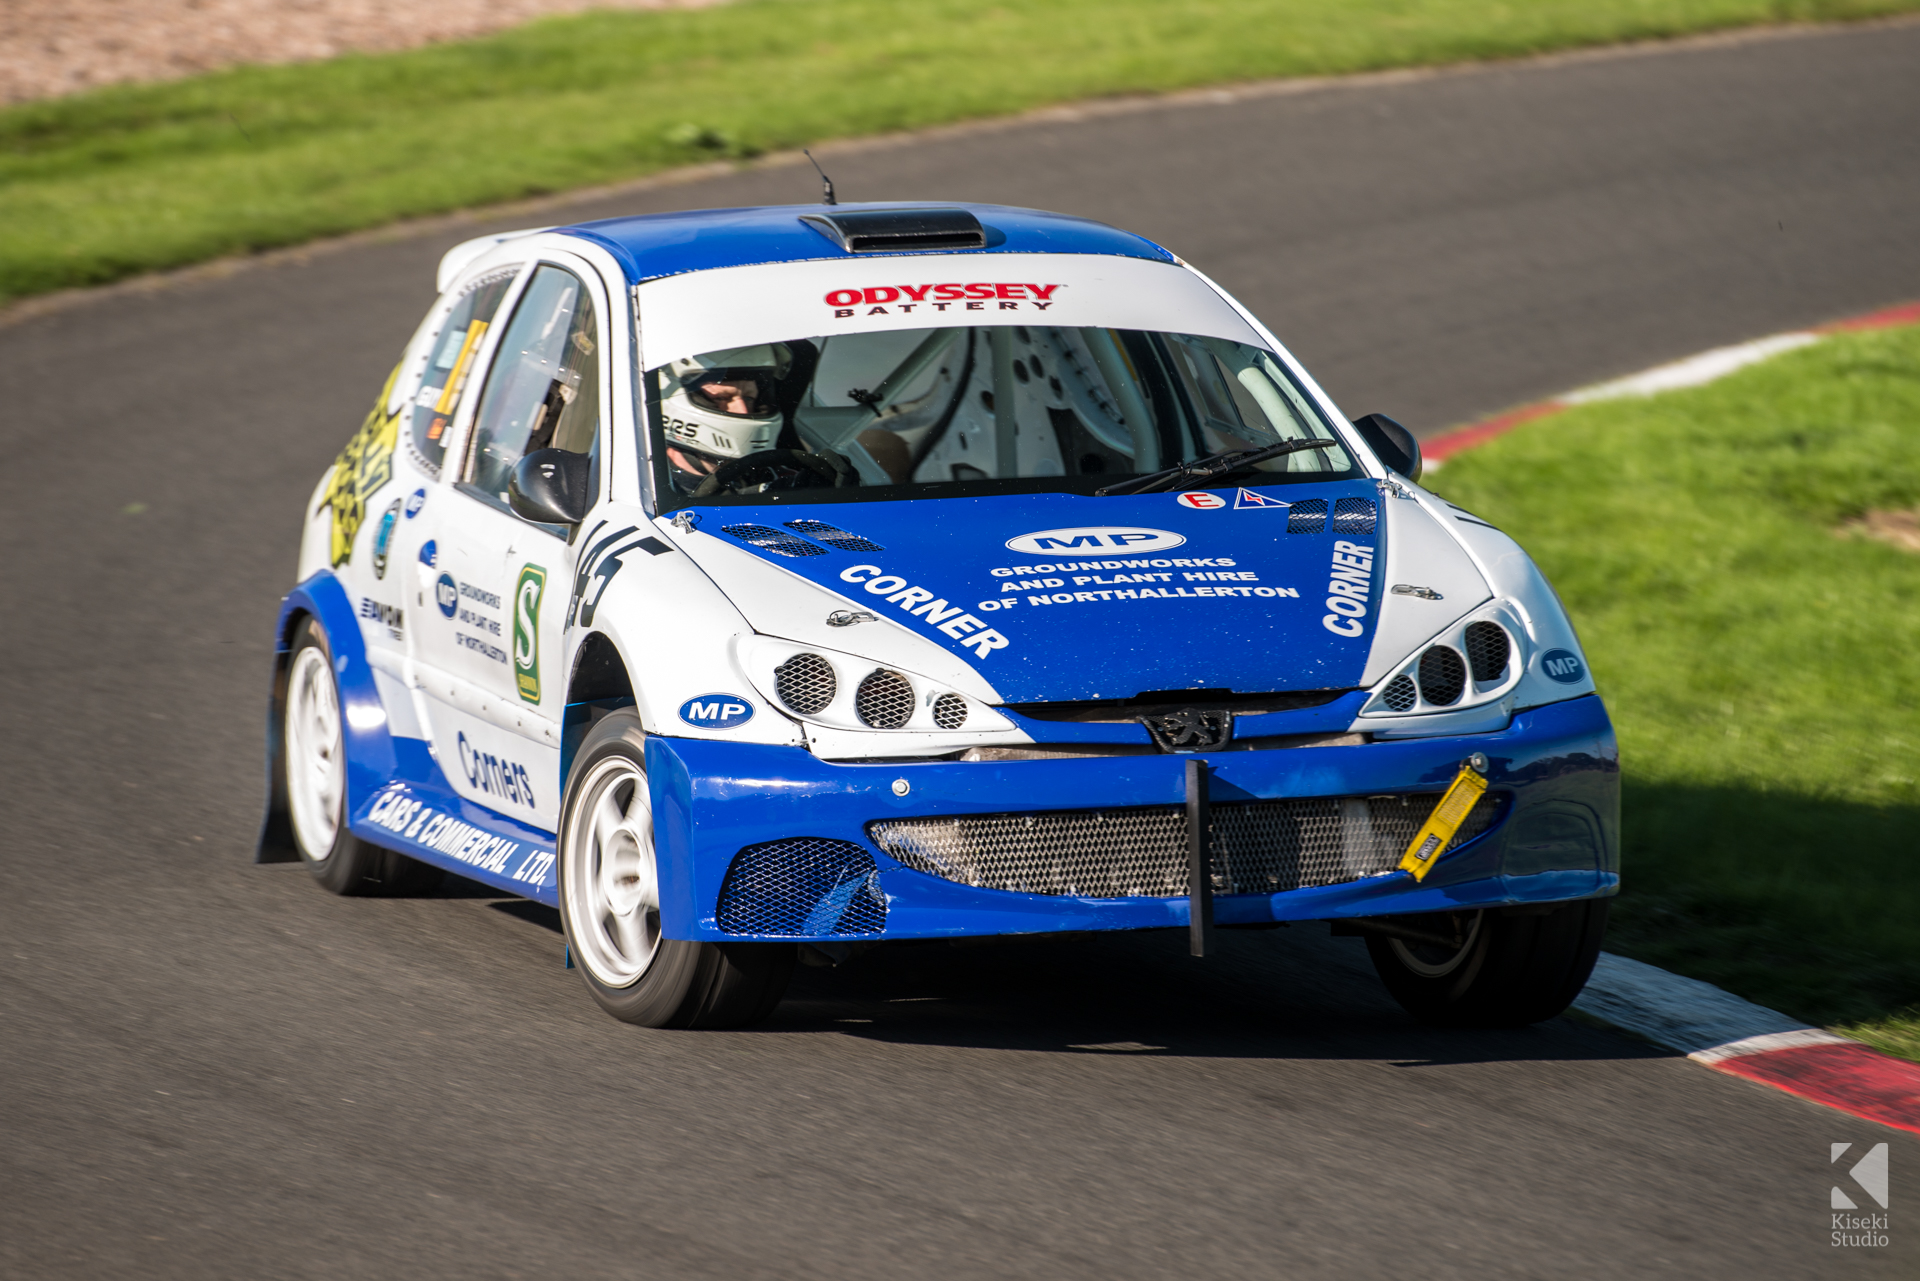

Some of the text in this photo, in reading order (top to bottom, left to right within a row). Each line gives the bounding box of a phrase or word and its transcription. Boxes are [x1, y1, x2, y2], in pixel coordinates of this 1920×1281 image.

[824, 283, 1061, 307] ODYSSEY
[834, 301, 1053, 318] BATTERY
[1033, 533, 1159, 550] MP
[990, 558, 1237, 577] GROUNDWORKS
[1000, 571, 1260, 593] AND PLANT HIRE
[1322, 540, 1374, 638] CORNER
[978, 586, 1300, 612] OF NORTHALLERTON
[515, 579, 541, 670] S
[840, 565, 1010, 660] CORNER
[1545, 657, 1580, 677] MP
[688, 701, 746, 721] MP
[457, 730, 536, 809] Corners
[367, 791, 422, 833] CARS
[403, 808, 433, 838] &
[417, 813, 520, 874] COMMERCIAL
